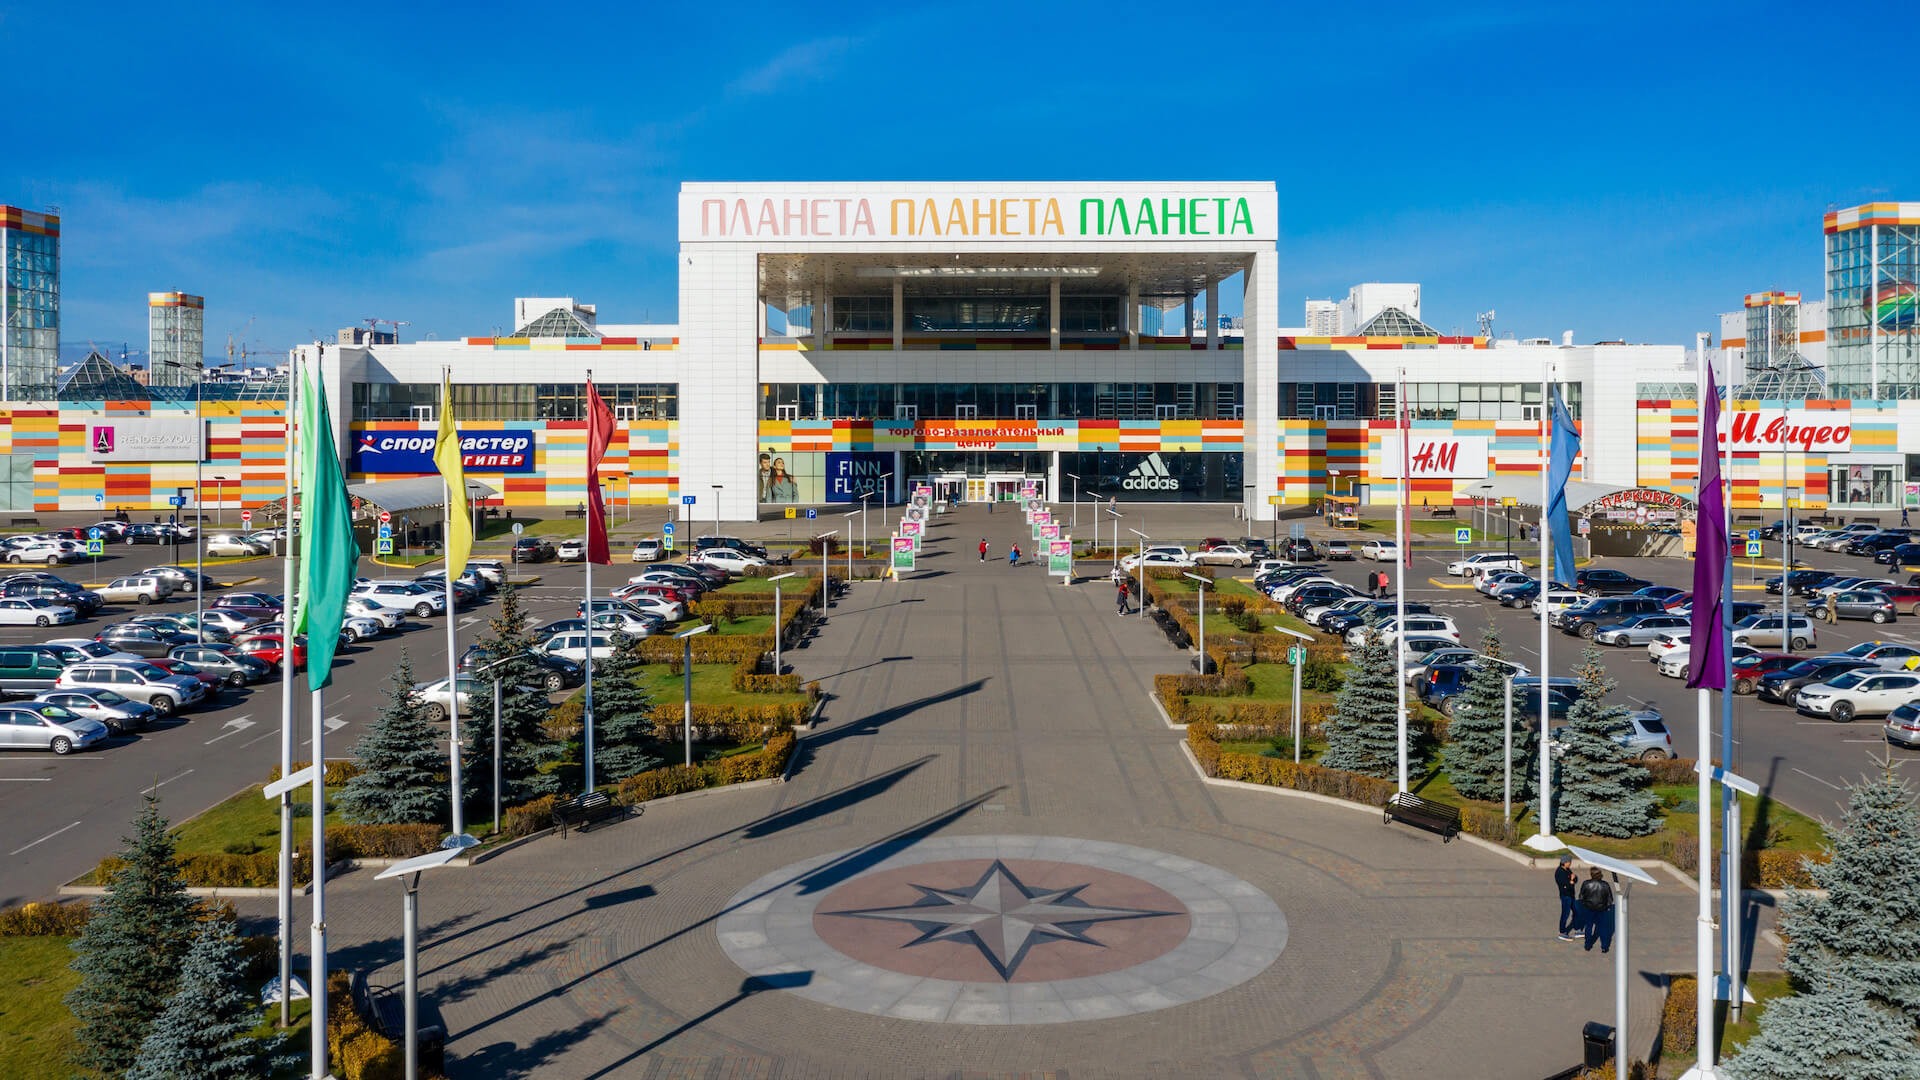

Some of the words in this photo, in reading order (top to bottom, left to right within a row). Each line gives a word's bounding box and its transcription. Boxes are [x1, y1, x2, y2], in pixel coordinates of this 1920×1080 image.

[702, 199, 875, 236] ПЛАНЕТА
[890, 198, 1065, 236] ПЛАНЕТА
[1079, 197, 1255, 236] ПЛАНЕТА
[888, 427, 1065, 438] торгово-развлекательный
[380, 436, 528, 454] спорастер
[957, 440, 996, 449] центр
[463, 455, 522, 465] ГИПЕР
[1412, 442, 1459, 473] H&M
[839, 461, 881, 476] FINN
[835, 478, 885, 494] FLARE
[1122, 476, 1179, 490] adidas
[1601, 490, 1682, 508] ПАРКОВКА
